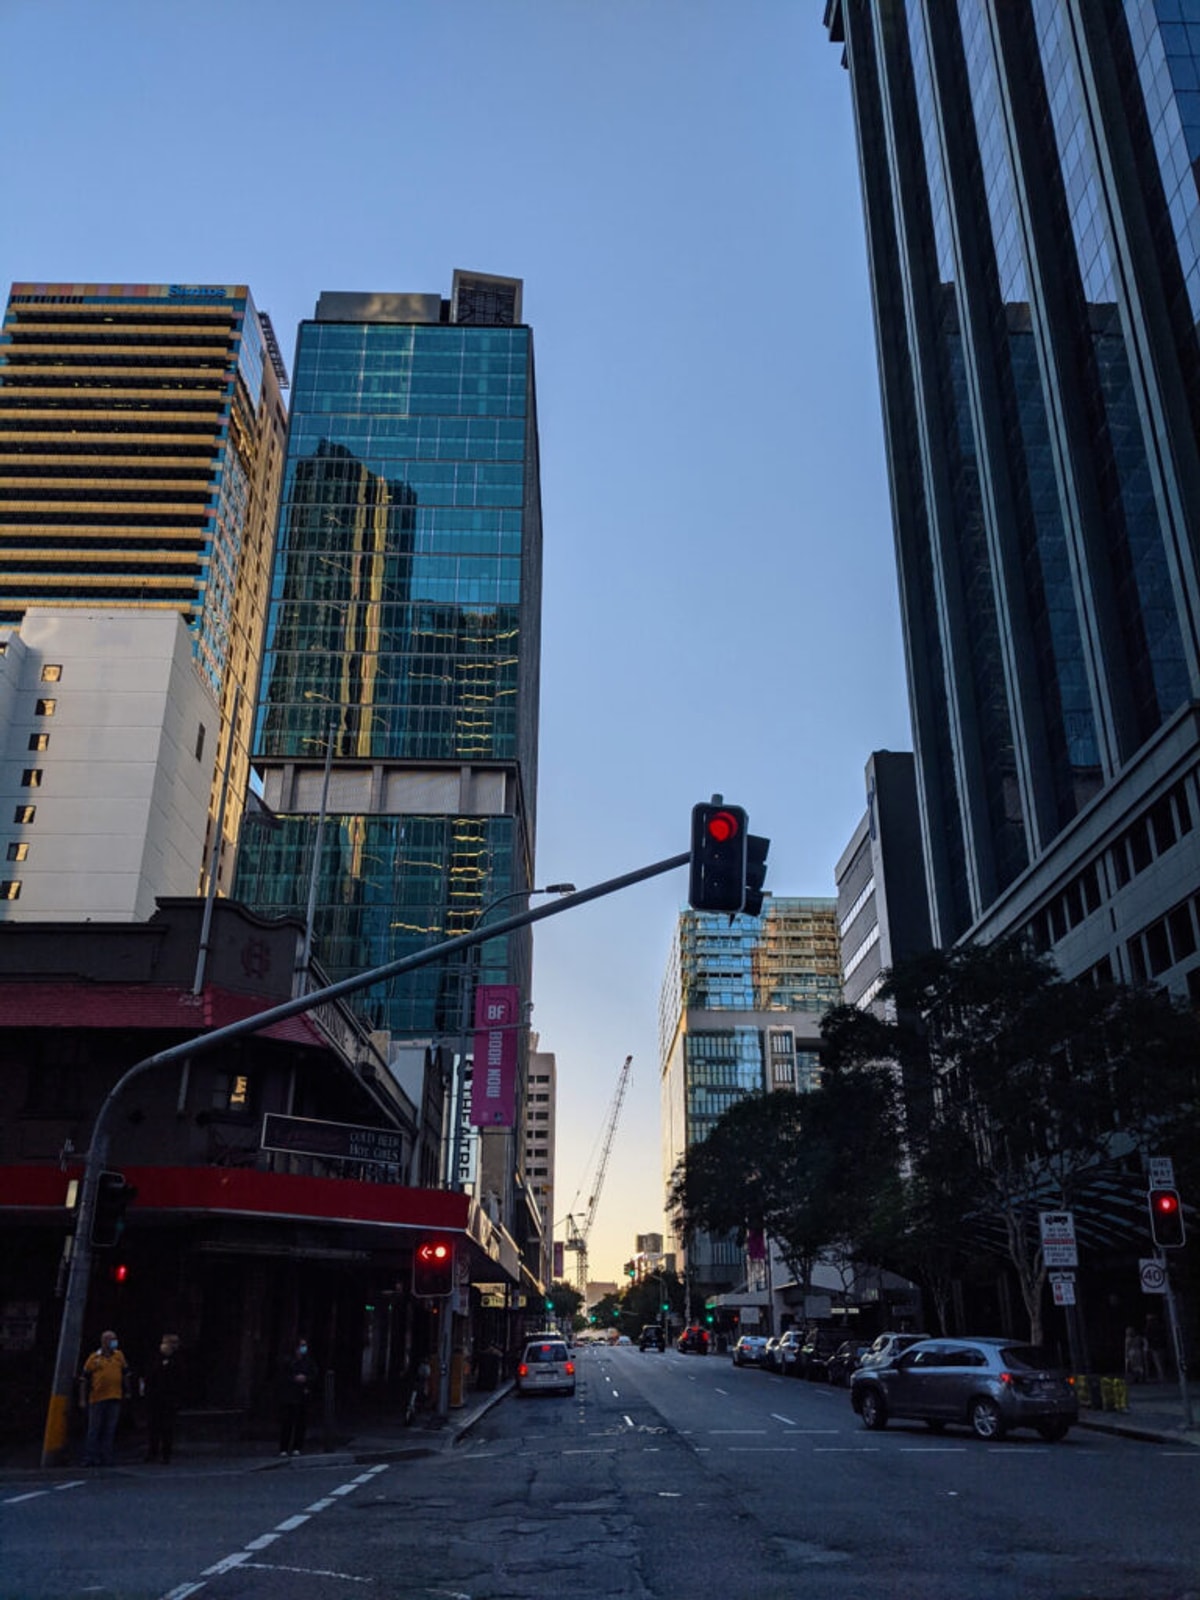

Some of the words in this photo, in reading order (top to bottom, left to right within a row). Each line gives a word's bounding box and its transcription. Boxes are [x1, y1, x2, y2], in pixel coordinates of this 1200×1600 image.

[487, 1004, 505, 1020] BF
[488, 1031, 503, 1065] BOOK
[486, 1068, 502, 1098] NOW
[1144, 1269, 1162, 1283] 40
